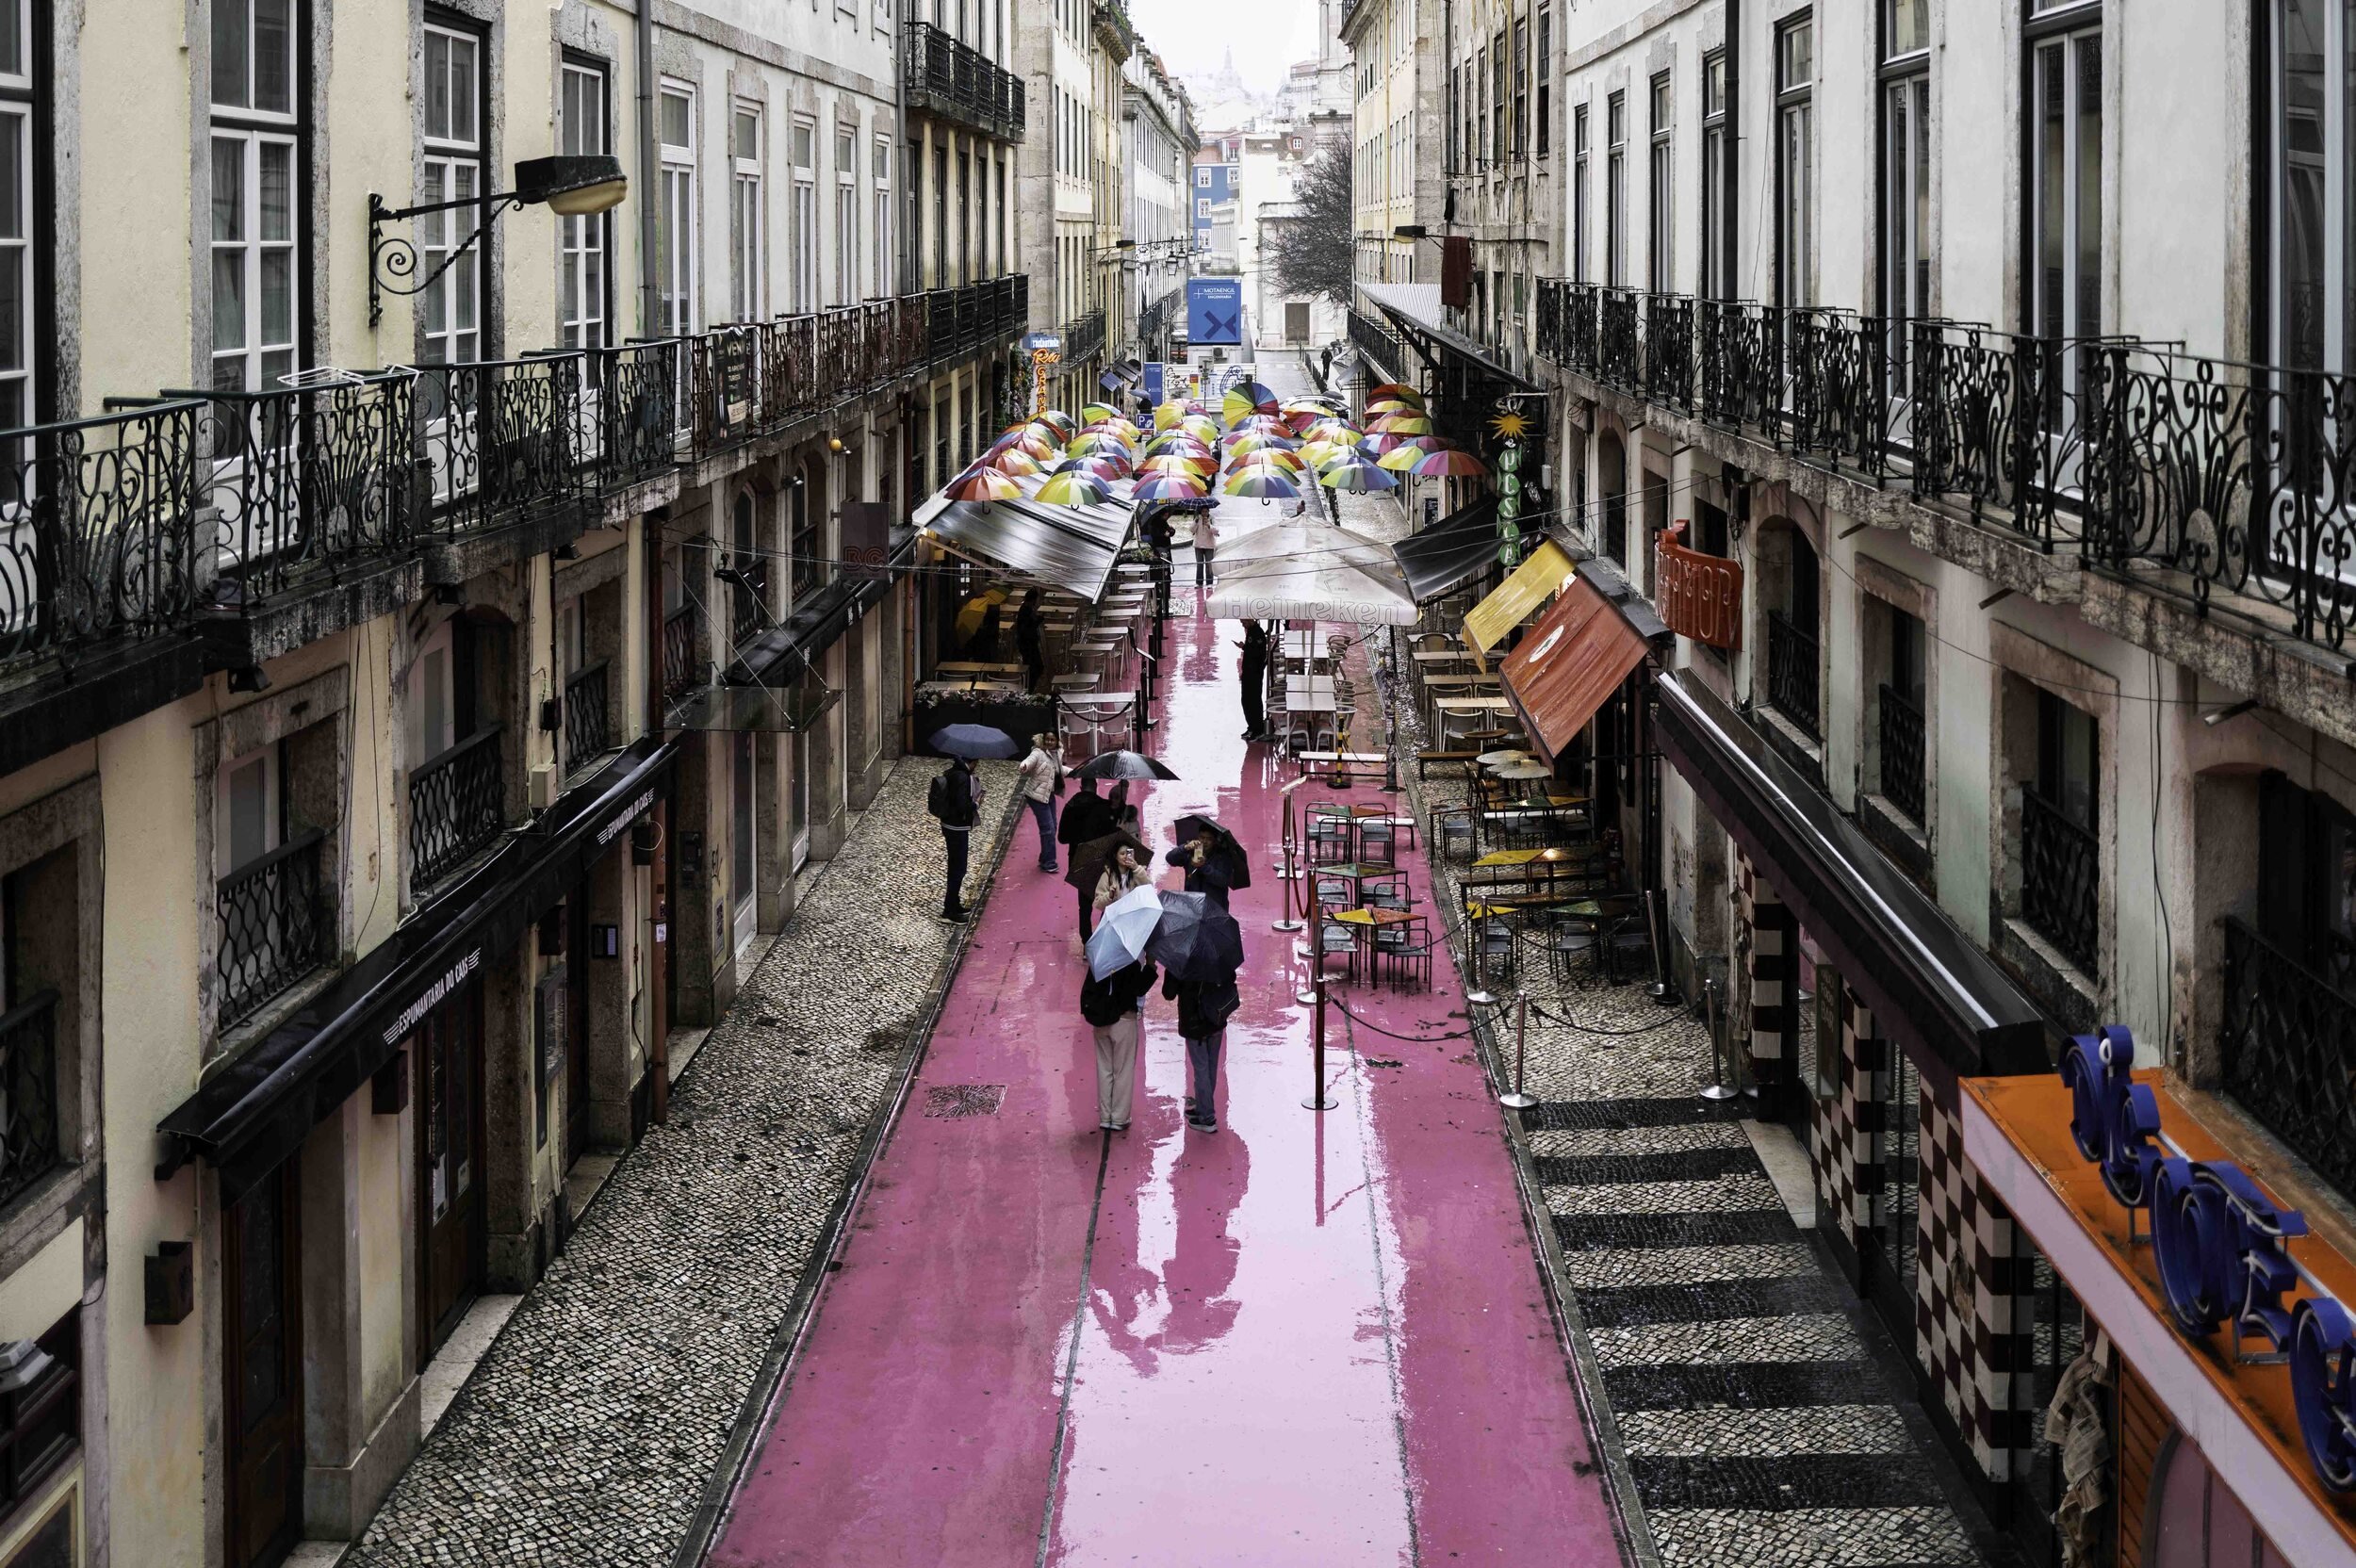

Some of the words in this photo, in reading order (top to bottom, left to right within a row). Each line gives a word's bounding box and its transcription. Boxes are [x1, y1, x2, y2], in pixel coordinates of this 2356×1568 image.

[1138, 416, 1146, 426] P
[843, 546, 885, 572] BC
[1224, 595, 1400, 626] Heineken
[634, 799, 640, 815] DO
[399, 978, 446, 1035] ESPUMANTARIA
[446, 969, 454, 992] DO
[454, 956, 468, 983] CAIS
